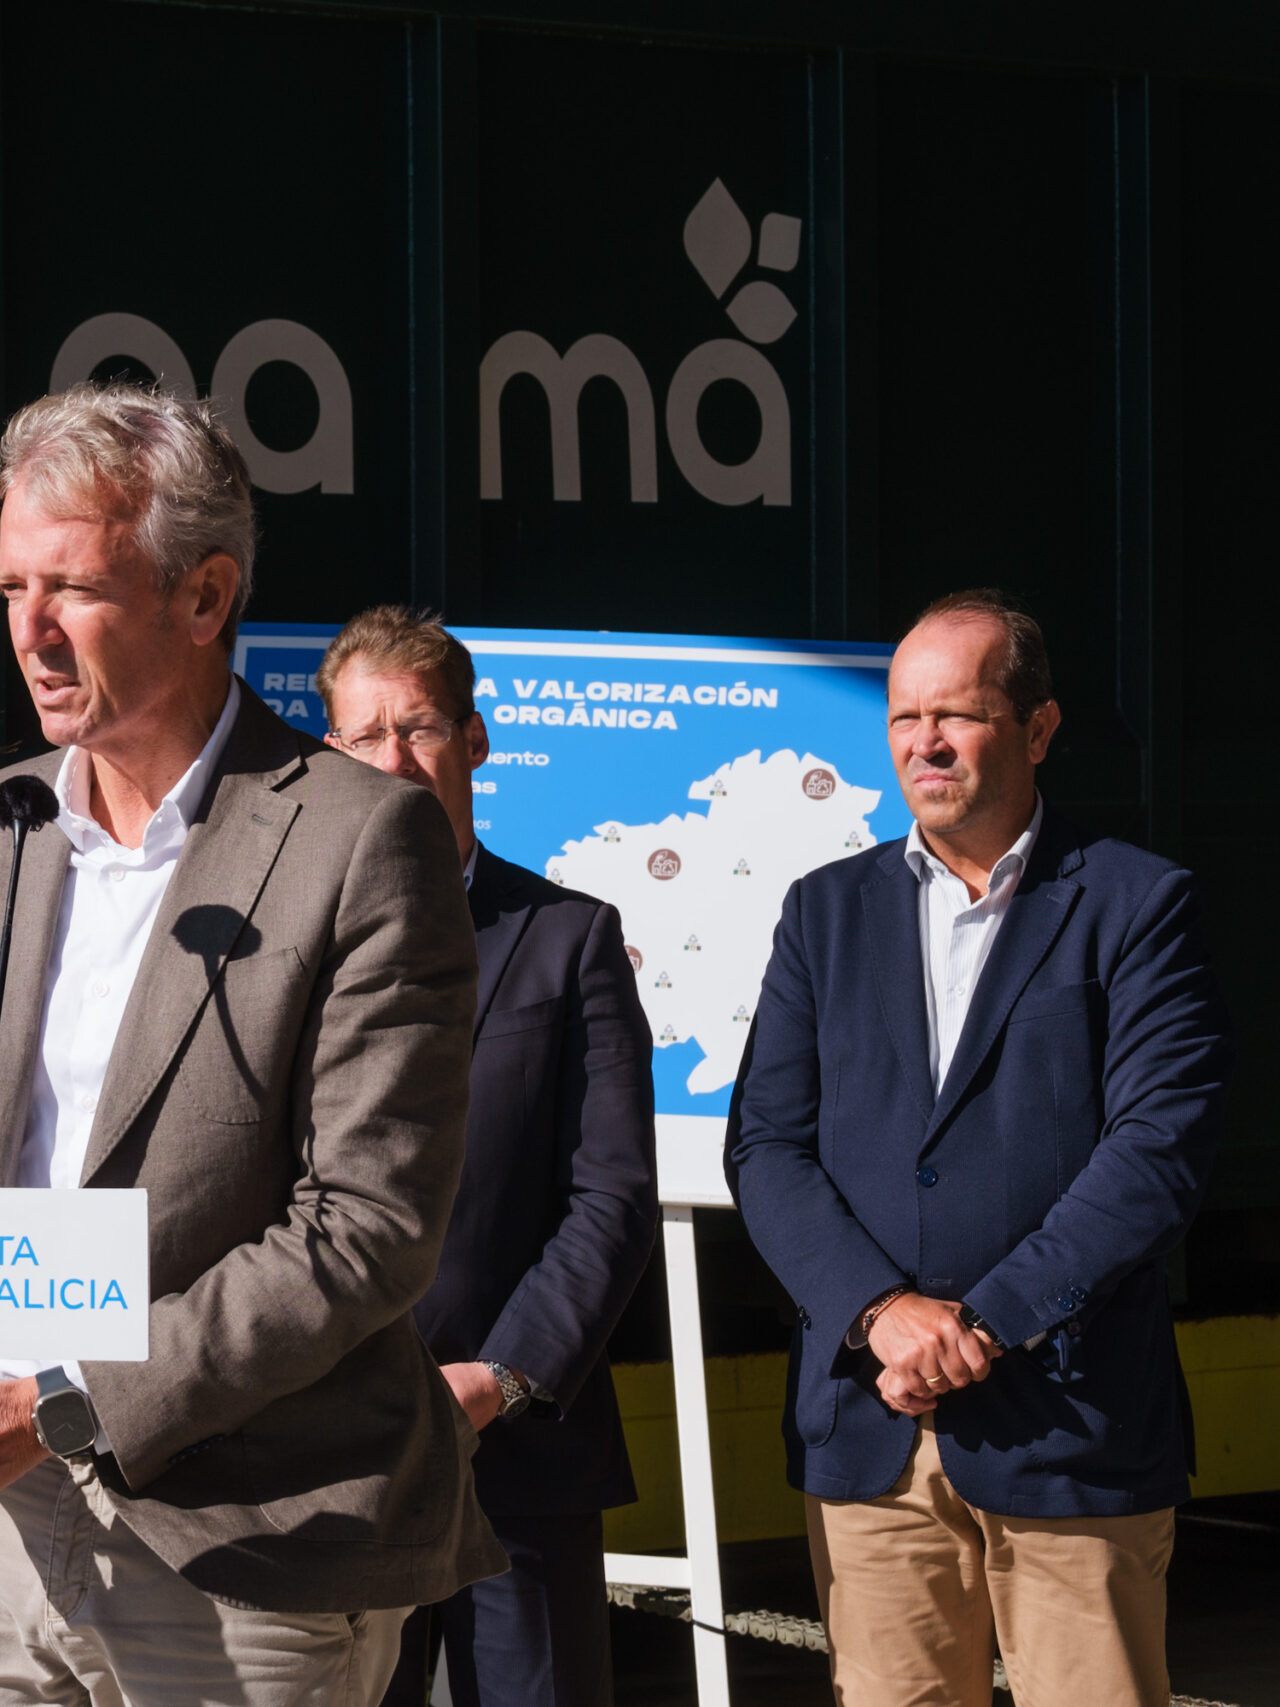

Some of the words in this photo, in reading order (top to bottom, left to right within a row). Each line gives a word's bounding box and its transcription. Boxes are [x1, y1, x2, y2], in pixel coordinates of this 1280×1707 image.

[512, 678, 779, 709] VALORIZACIÓN
[493, 701, 678, 730] ORGÁNICA
[486, 750, 550, 766] ento
